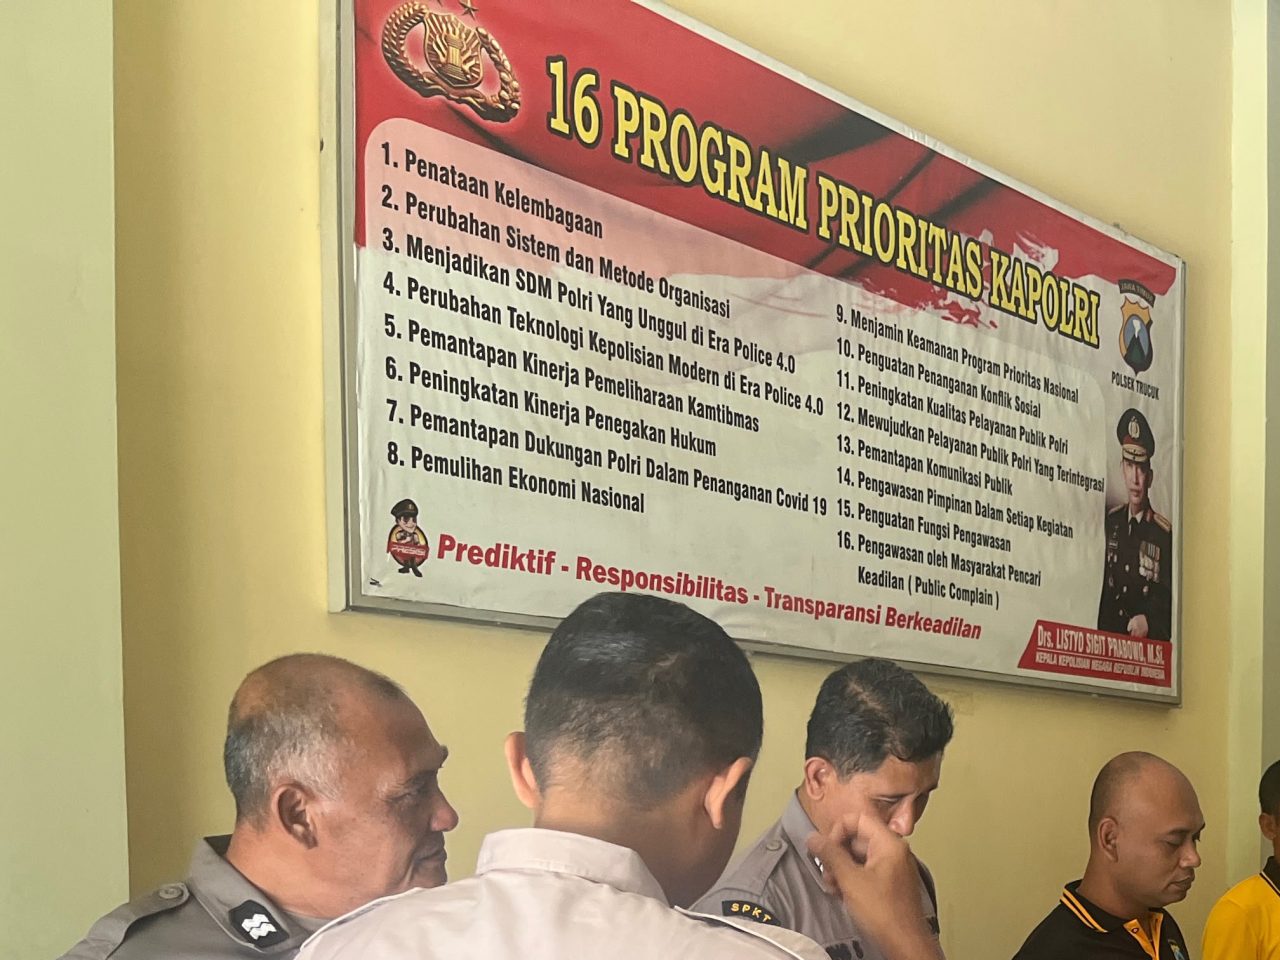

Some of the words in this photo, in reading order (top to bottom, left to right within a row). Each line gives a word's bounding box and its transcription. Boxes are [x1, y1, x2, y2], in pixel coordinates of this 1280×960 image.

[381, 141, 399, 168] 1.
[405, 148, 489, 200] Penataan
[494, 180, 603, 239] Kelembagaan
[548, 58, 601, 146] 16
[612, 84, 809, 231] PROGRAM
[817, 174, 984, 300] PRIORITAS
[989, 249, 1101, 346] KAPOLRI
[381, 184, 399, 211] 2.
[405, 191, 501, 244] Perubahan
[506, 225, 560, 263] Sistem
[565, 246, 594, 275] dan
[599, 256, 654, 294] Metode
[658, 276, 730, 319] Organisasi
[382, 227, 400, 254] 3.
[406, 233, 510, 287] Menjadikan
[515, 268, 552, 300] SDM
[557, 281, 593, 313] Polri
[597, 293, 633, 329] Yang
[638, 306, 687, 342] Unggul
[691, 325, 704, 346] di
[708, 328, 730, 355] Era
[734, 337, 773, 367] Police
[776, 351, 796, 374] 4.0
[383, 271, 401, 297] 4.
[407, 276, 502, 325] Perubahan
[506, 305, 584, 351] Teknologi
[588, 329, 664, 371] Kepolisian
[668, 353, 720, 387] Modern
[724, 370, 736, 392] di
[739, 374, 761, 399] Era
[764, 381, 801, 410] Police
[804, 394, 824, 416] 4.0
[384, 312, 402, 339] 5.
[408, 319, 517, 370] Pemantapan
[522, 350, 580, 388] Kinerja
[585, 366, 684, 413] Pemeliharaan
[687, 395, 759, 433] Kamtibmas
[836, 303, 848, 325] 9.
[850, 308, 904, 344] Menjamin
[907, 328, 959, 363] Keamanan
[961, 347, 1001, 377] Program
[1003, 362, 1041, 391] Prioritas
[1043, 376, 1079, 404] Nasional
[836, 336, 855, 359] 10.
[858, 343, 915, 378] Penguatan
[917, 363, 978, 399] Penanganan
[980, 384, 1012, 410] Konflik
[1014, 395, 1041, 419] Sosial
[1111, 370, 1135, 393] POLSEK
[385, 356, 403, 382] 6.
[409, 361, 519, 409] Peningkatan
[524, 390, 580, 427] Kinerja
[585, 405, 666, 445] Penegakan
[670, 426, 717, 457] Hukum
[836, 369, 856, 392] 11.
[858, 375, 924, 412] Peningkatan
[926, 396, 967, 425] Kualitas
[969, 409, 1017, 440] Pelayanan
[1019, 425, 1047, 450] Publik
[1048, 433, 1069, 456] Polri
[836, 401, 856, 424] 12.
[858, 407, 925, 443] Mewujudkan
[927, 427, 978, 457] Pelayanan
[980, 442, 1009, 466] Publik
[1011, 451, 1032, 473] Polri
[1033, 458, 1055, 483] Yang
[1055, 465, 1106, 494] Terintegrasi
[386, 398, 404, 424] 7.
[410, 403, 519, 449] Pemantapan
[525, 430, 603, 468] Dukungan
[607, 449, 641, 476] Polri
[646, 457, 689, 486] Dalam
[693, 468, 772, 504] Penanganan
[776, 487, 809, 512] Covid
[812, 496, 827, 516] 19
[387, 441, 405, 467] 8.
[411, 445, 503, 486] Pemulihan
[508, 465, 576, 500] Ekonomi
[581, 480, 645, 514] Nasional
[836, 433, 855, 455] 13.
[858, 439, 924, 473] Pemantapan
[926, 457, 982, 488] Komunikasi
[984, 472, 1013, 496] Publik
[836, 466, 855, 487] 14.
[857, 470, 924, 503] Pengawasan
[927, 487, 972, 515] Pimpinan
[975, 499, 1004, 522] Dalam
[1006, 507, 1034, 533] Setiap
[1036, 515, 1074, 539] Kegiatan
[837, 498, 855, 519] 15.
[858, 502, 915, 532] Penguatan
[917, 515, 950, 541] Fungsi
[953, 523, 1011, 553] Pengawasan
[436, 532, 557, 576] Prediktif
[575, 555, 749, 605] Responsibilitas
[763, 585, 882, 625] Transparansi
[884, 606, 983, 641] Berkeadilan
[837, 530, 855, 551] 16.
[858, 533, 924, 564] Pengawasan
[926, 549, 948, 569] oleh
[950, 552, 1006, 580] Masyarakat
[1008, 564, 1042, 587] Pencari
[858, 565, 905, 591] Keadilan
[915, 575, 946, 598] Public
[948, 582, 993, 607] Complain
[1037, 624, 1054, 648] Drs.
[1056, 627, 1084, 653] LISTYO
[1086, 632, 1106, 656] SIGIT
[730, 902, 772, 923] SPKT
